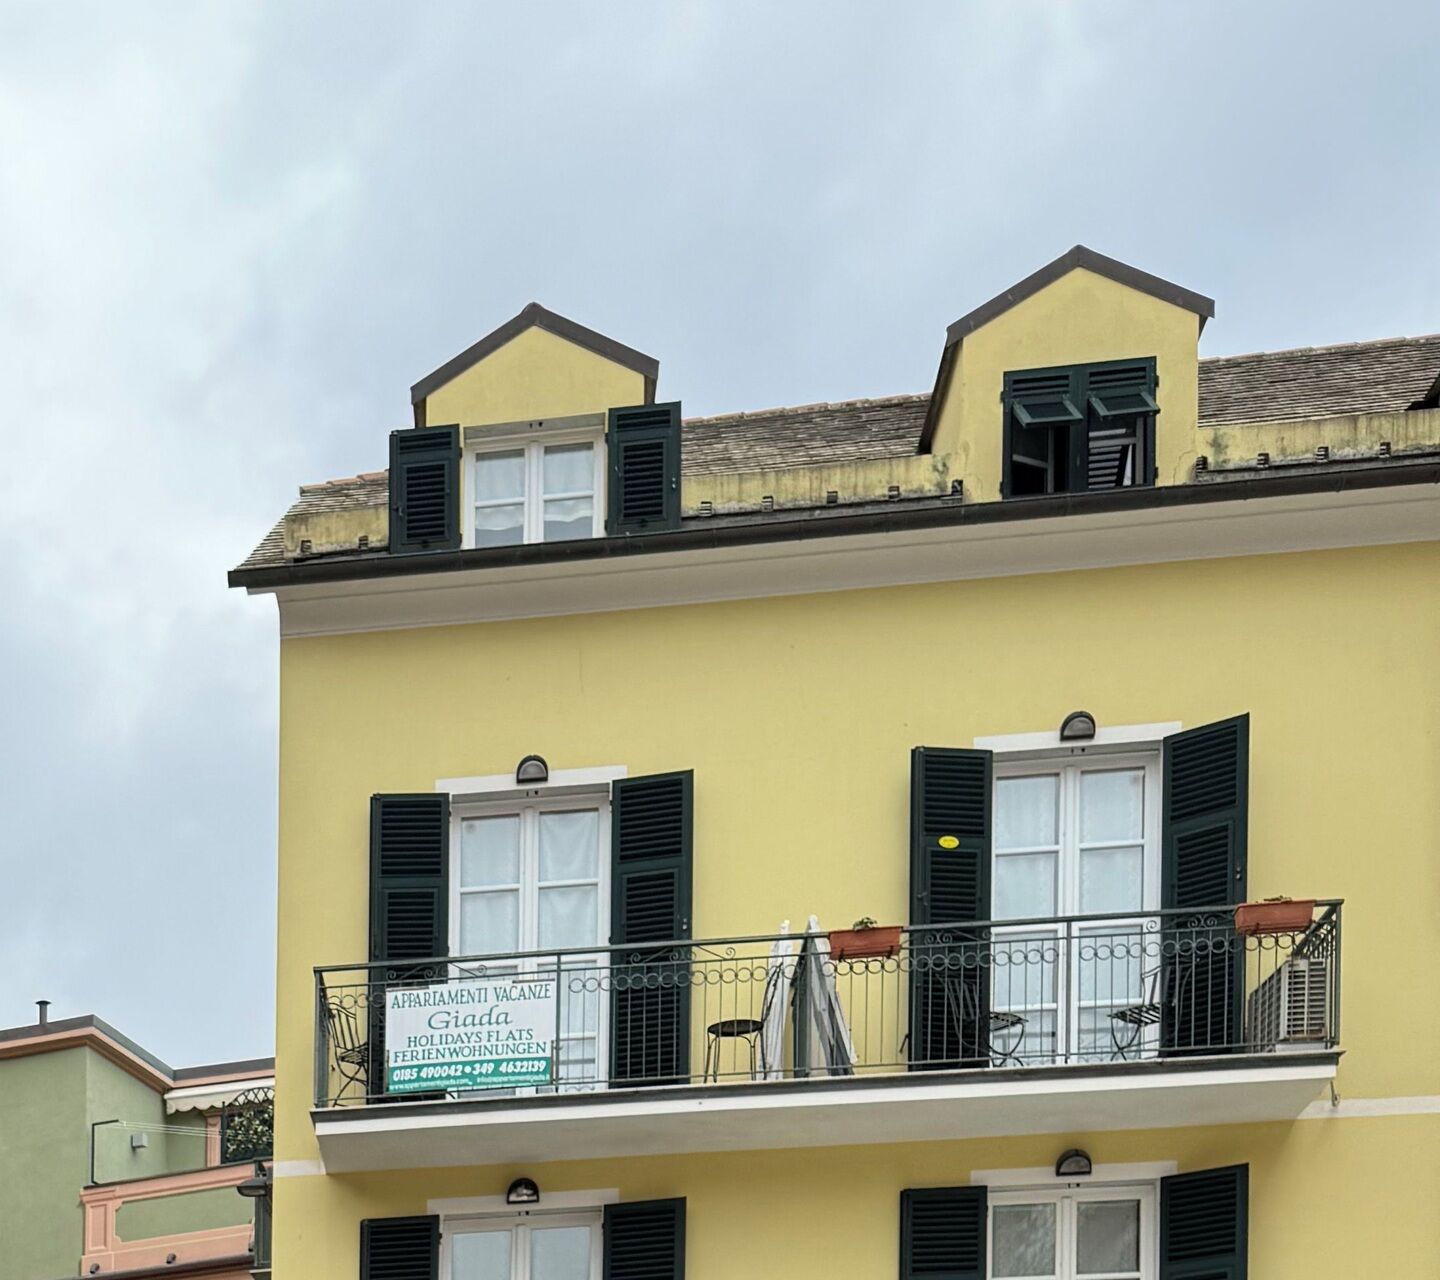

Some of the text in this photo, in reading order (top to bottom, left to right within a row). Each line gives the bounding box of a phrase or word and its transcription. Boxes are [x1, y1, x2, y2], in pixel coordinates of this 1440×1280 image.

[391, 984, 551, 1009] APPARTAMENTI VACANZE
[428, 1004, 512, 1030] Giada
[408, 1029, 534, 1048] HOLIDAYS FLATS
[394, 1042, 547, 1063] FERIENWOHNUNGEN
[393, 1060, 546, 1081] 0185 490042 349 4632139
